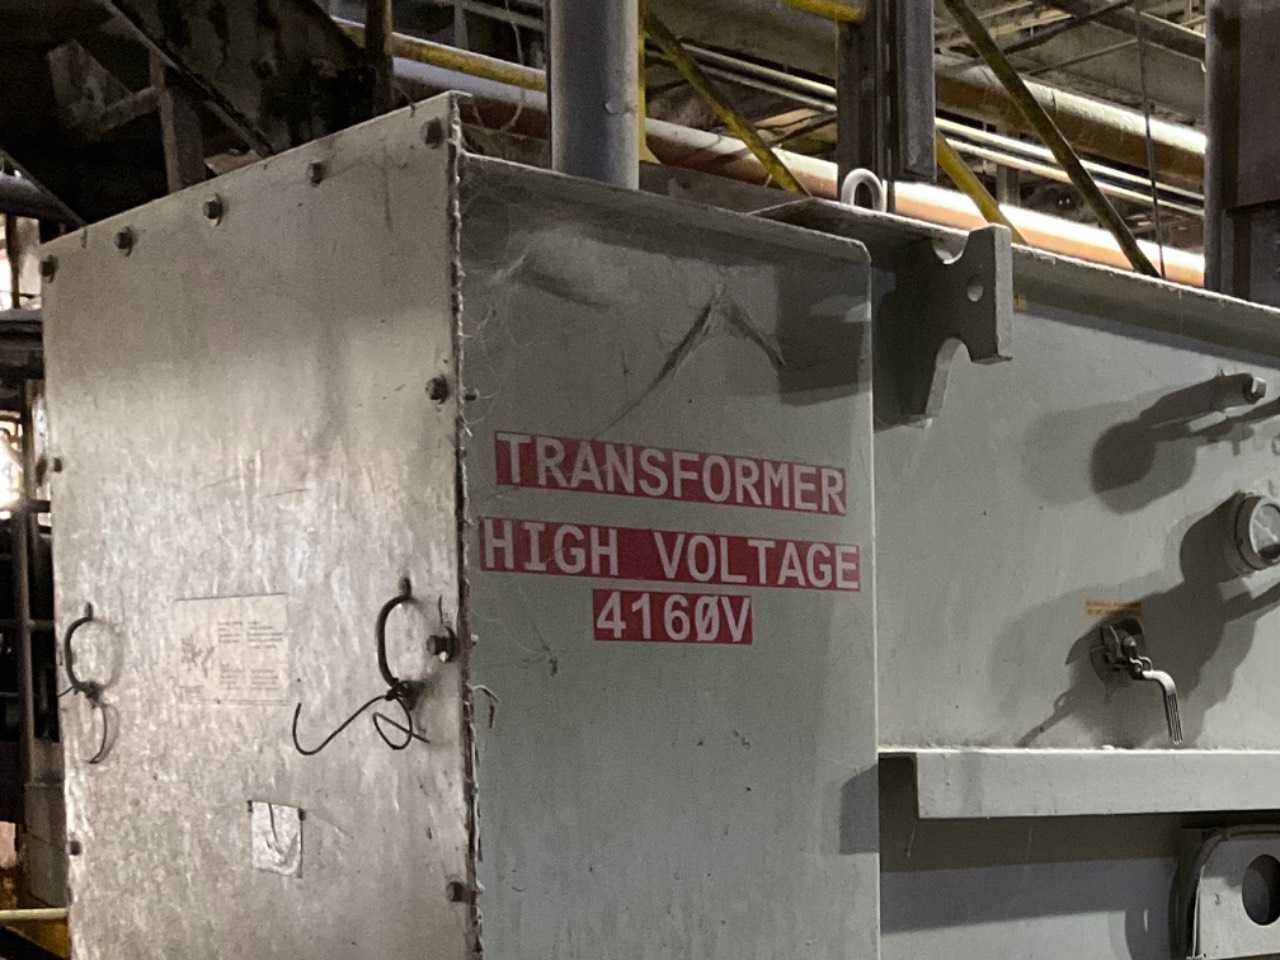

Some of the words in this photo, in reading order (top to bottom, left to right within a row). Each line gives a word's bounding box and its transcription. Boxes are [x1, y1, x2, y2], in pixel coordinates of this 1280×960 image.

[496, 432, 847, 515] TRANSFORMER
[483, 518, 619, 576] HIGH
[654, 531, 859, 590] VOLTAGE
